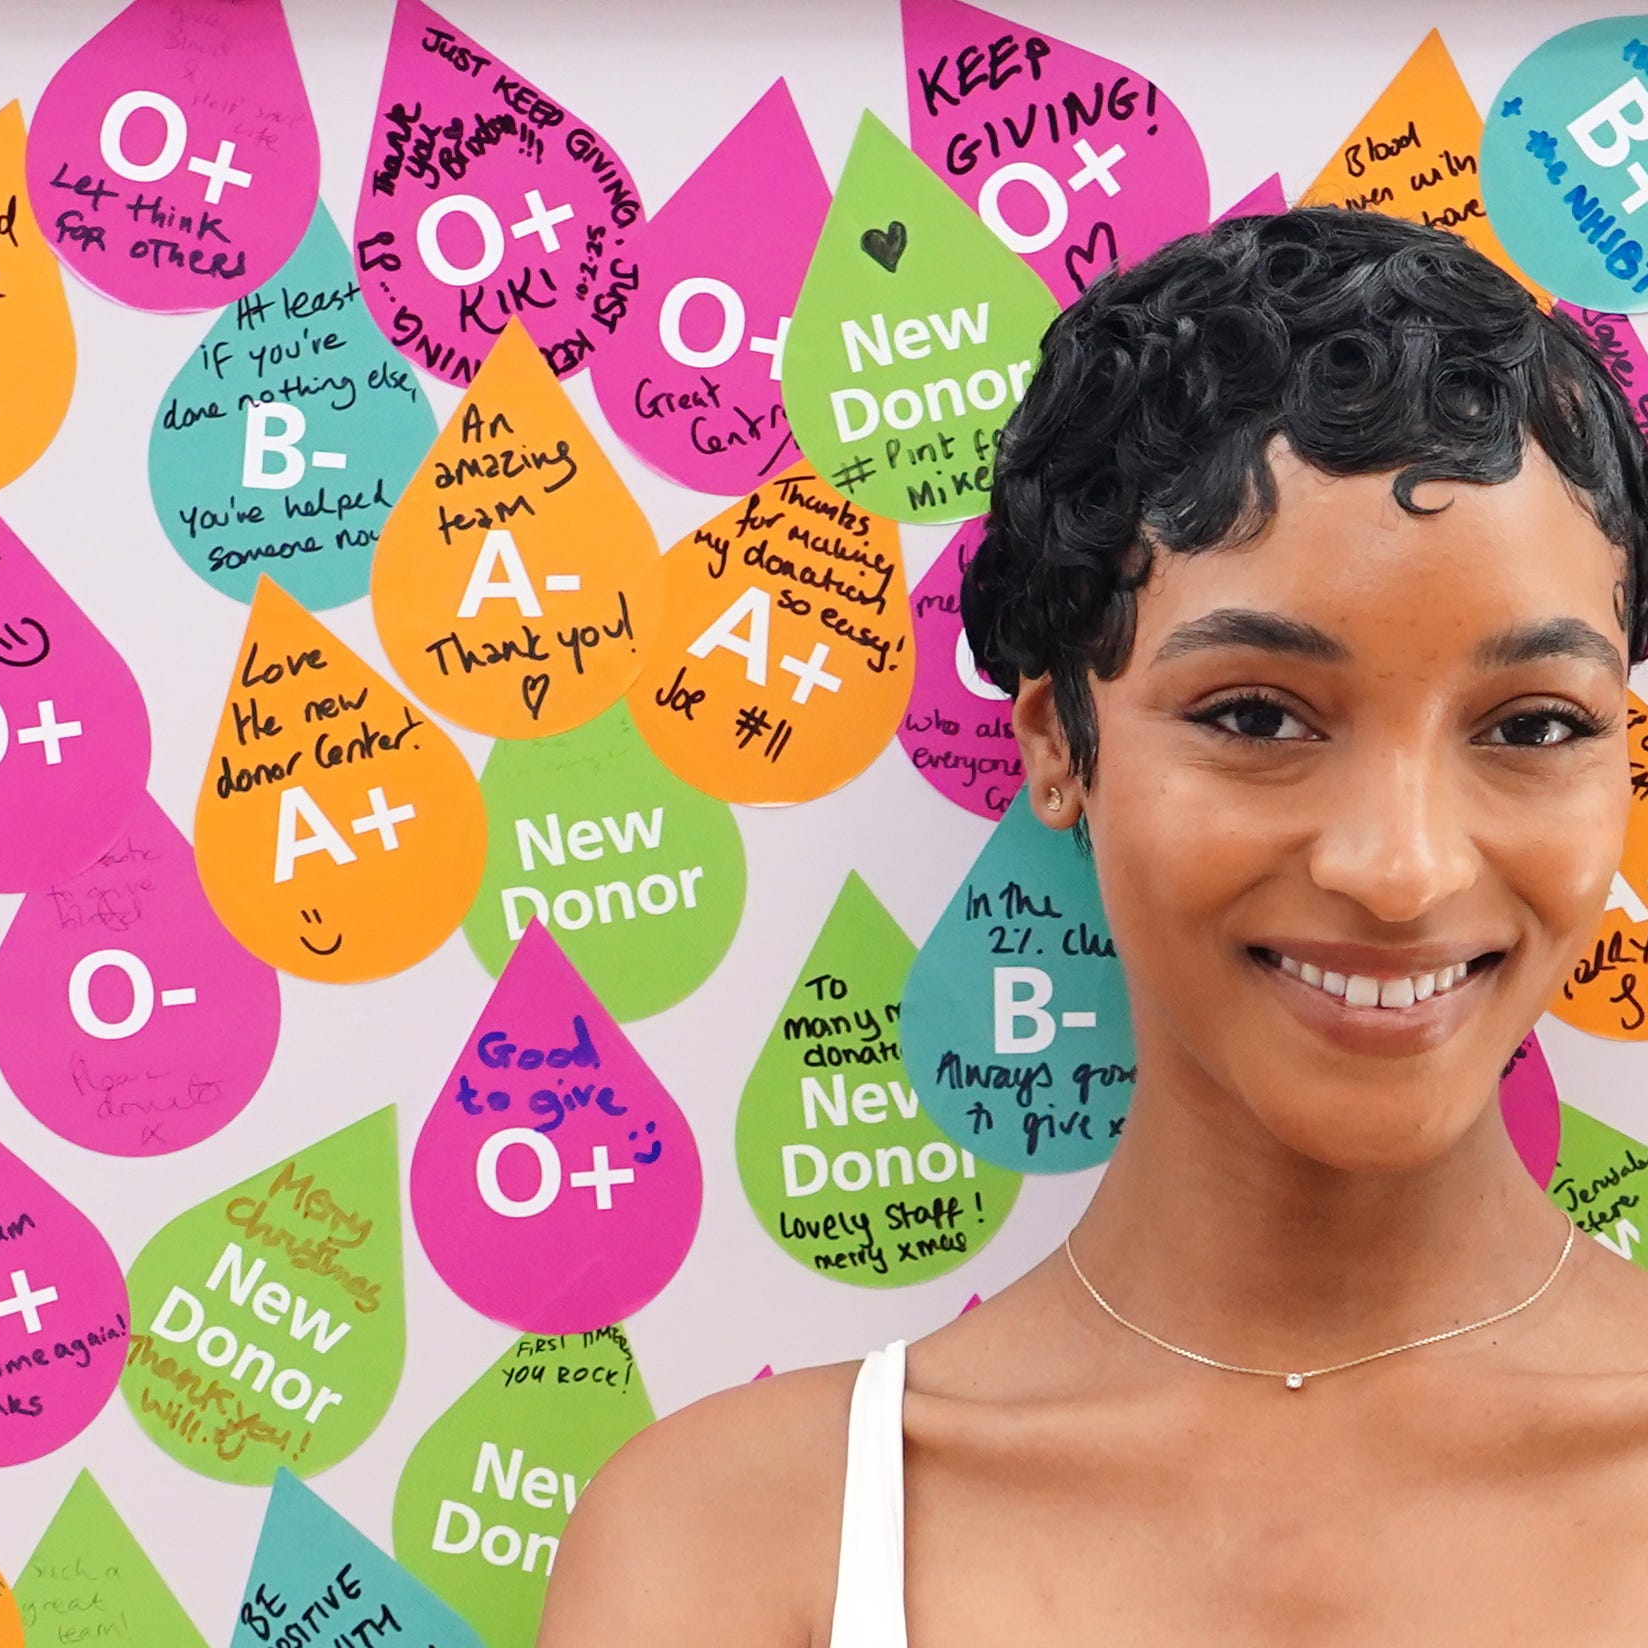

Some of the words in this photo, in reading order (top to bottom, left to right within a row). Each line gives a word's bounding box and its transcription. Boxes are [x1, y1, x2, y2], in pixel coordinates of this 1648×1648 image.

[917, 35, 1052, 116] KEEP
[945, 81, 1159, 177] GIVING!
[977, 137, 1128, 256] O+
[415, 188, 575, 288] O+
[458, 267, 557, 333] KIKI
[242, 402, 347, 491] B-
[433, 439, 578, 491] amazing
[460, 406, 513, 443] An
[284, 480, 393, 517] helped
[437, 496, 534, 546] team
[456, 529, 581, 620] A-
[242, 646, 328, 689] Love
[425, 626, 548, 679] Thank
[560, 593, 637, 668] you!
[216, 748, 300, 798] donor
[271, 784, 416, 885] A+
[67, 948, 198, 1042] O-
[477, 1016, 600, 1071] Good
[458, 1078, 513, 1115] to
[529, 1078, 629, 1133] give
[475, 1126, 636, 1219] O+
